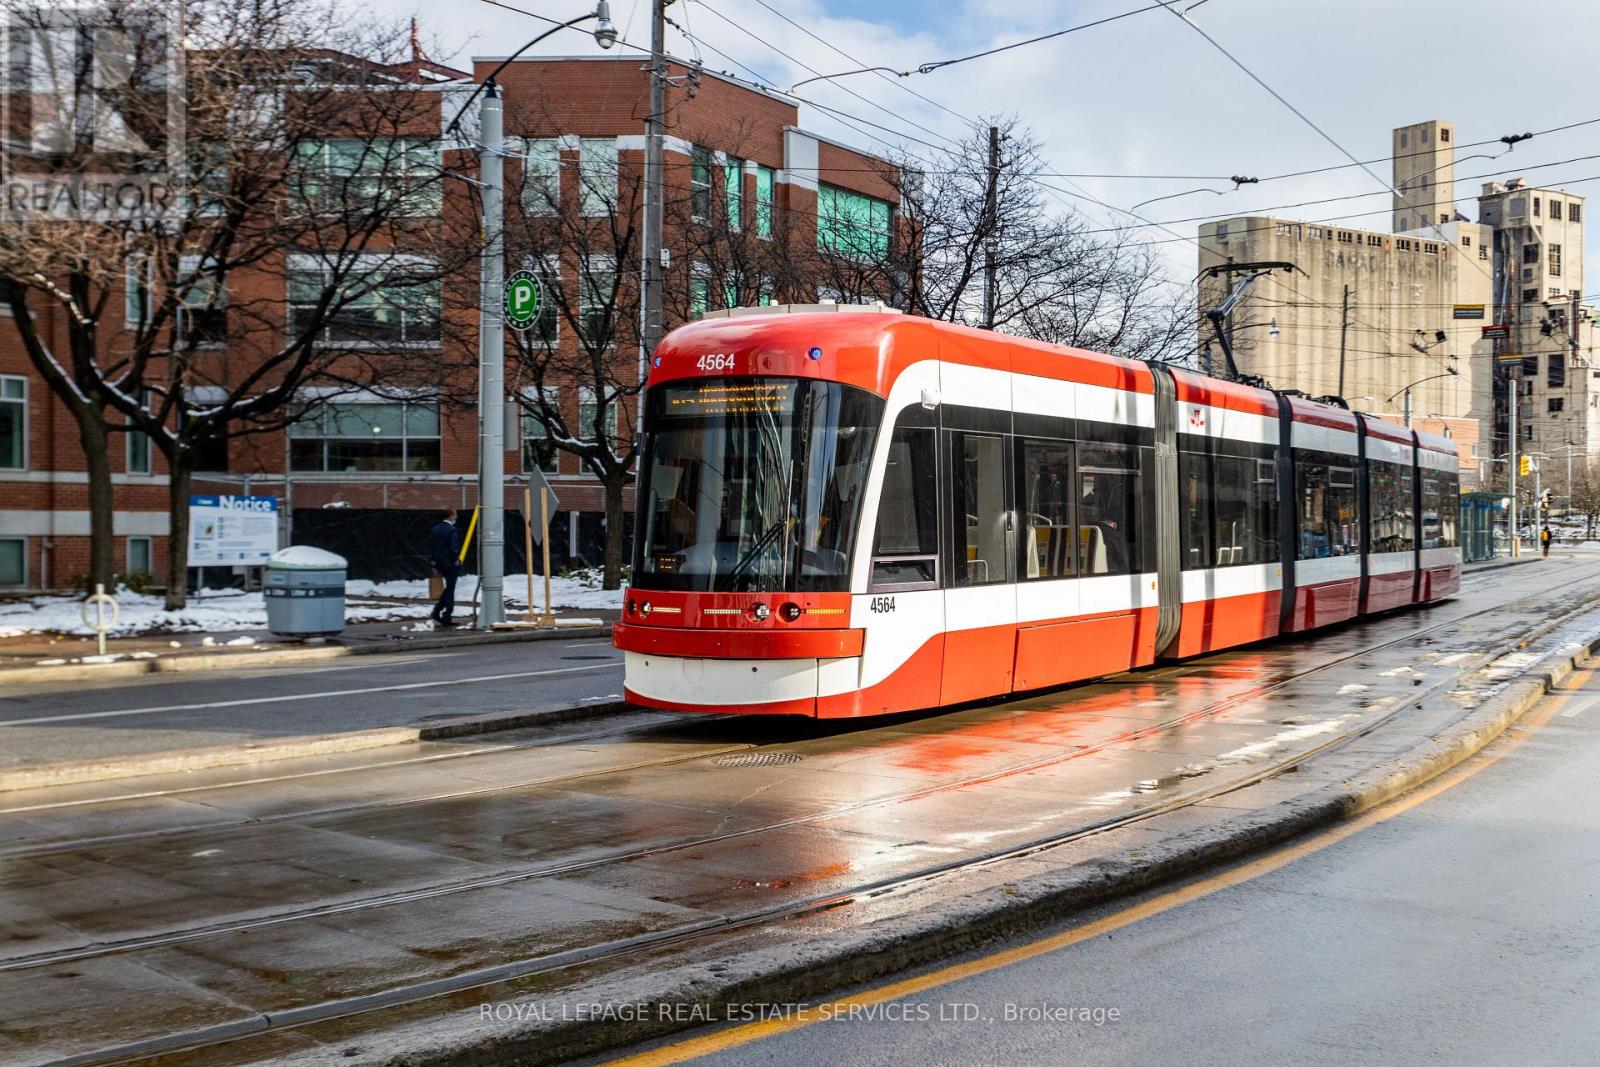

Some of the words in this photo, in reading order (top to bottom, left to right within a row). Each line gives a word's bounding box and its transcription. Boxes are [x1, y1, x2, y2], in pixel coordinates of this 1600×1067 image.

[515, 286, 531, 309] P
[696, 353, 735, 370] 4564
[219, 495, 271, 511] Notice
[870, 596, 895, 613] 4564
